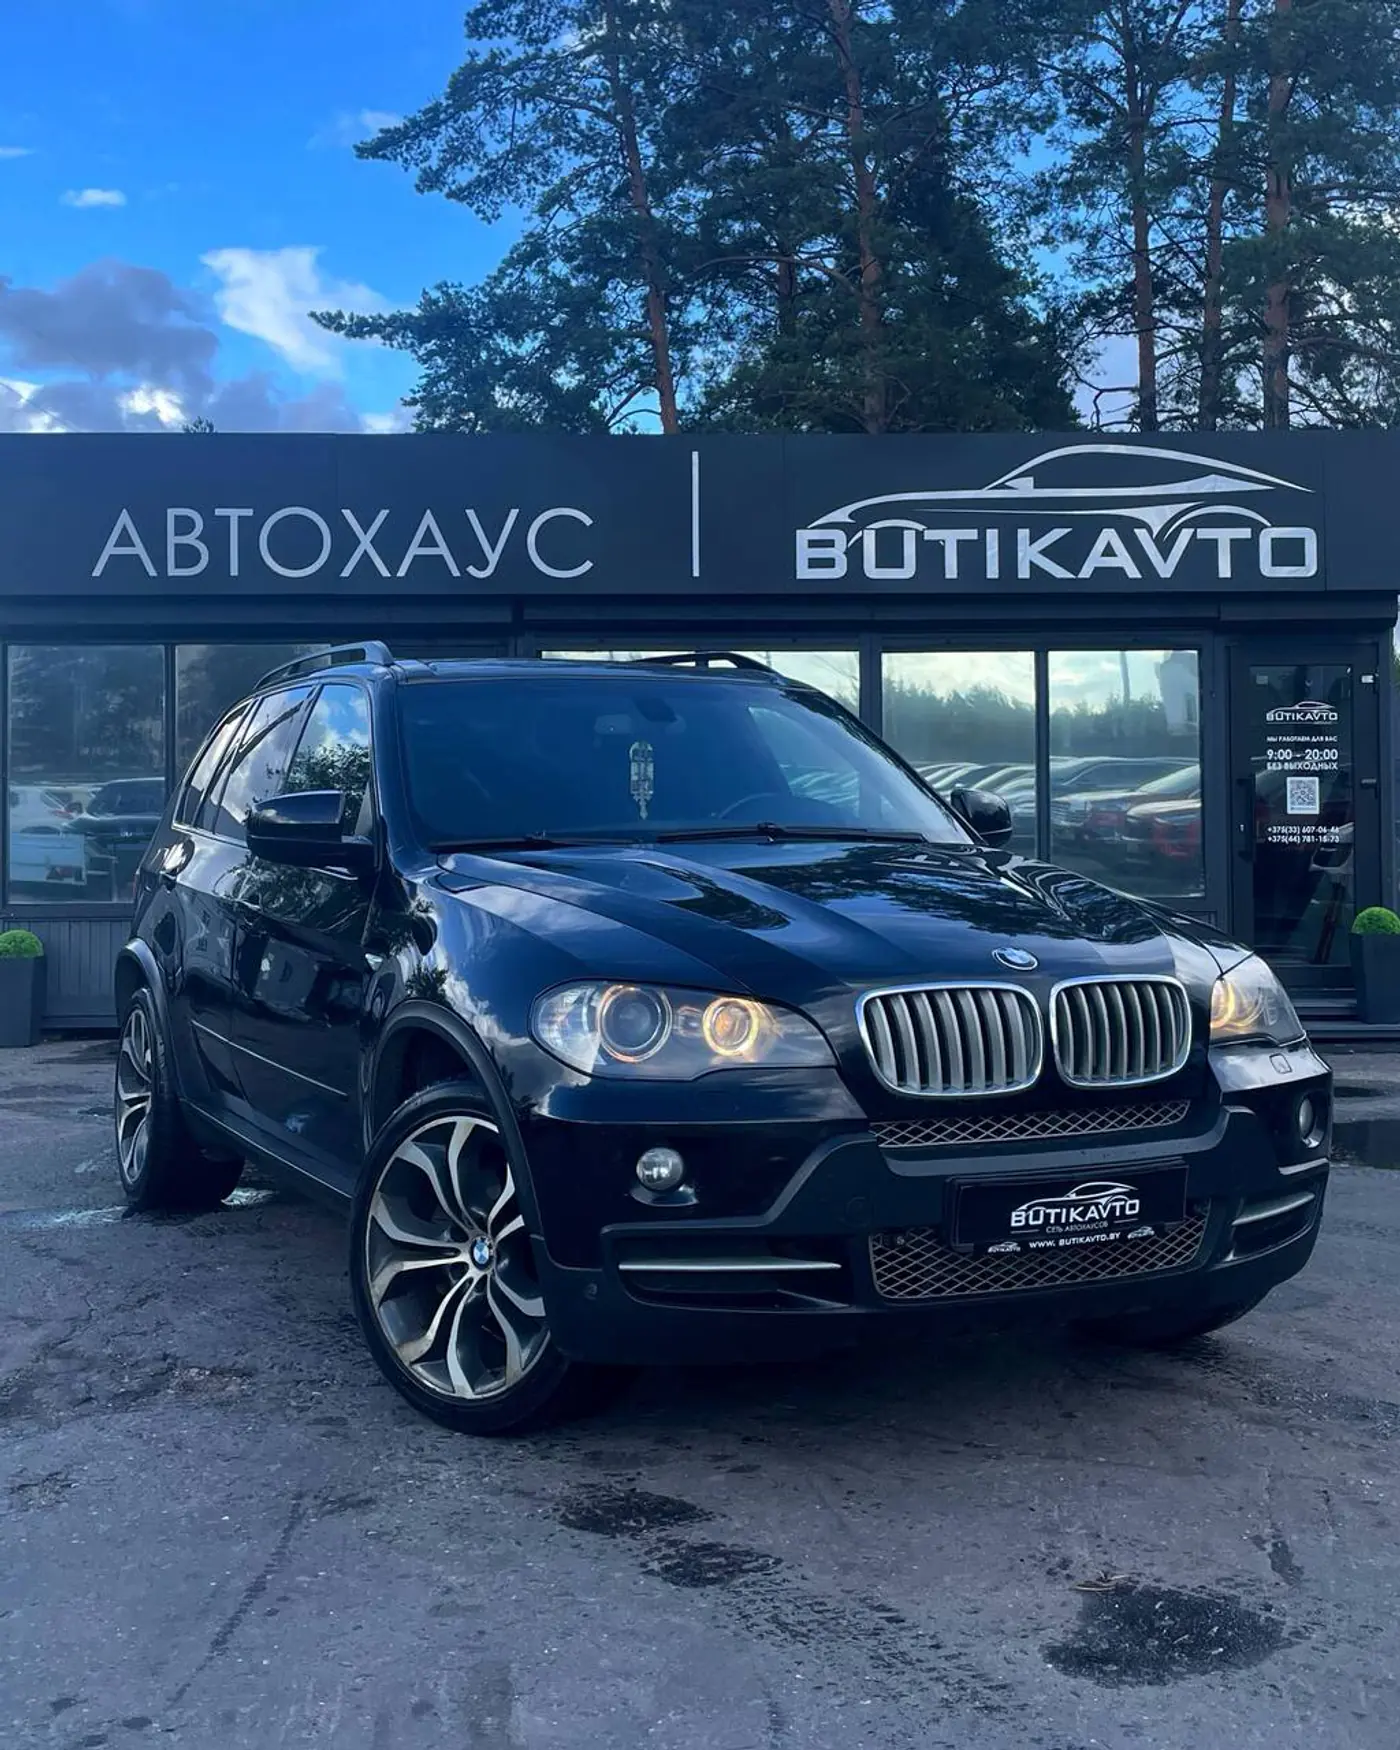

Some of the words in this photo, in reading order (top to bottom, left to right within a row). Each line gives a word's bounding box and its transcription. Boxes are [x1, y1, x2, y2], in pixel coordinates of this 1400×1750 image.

[92, 506, 594, 579] АВТОХАУС
[795, 527, 1318, 579] BUTIKAVTO
[1266, 712, 1338, 721] BUTIKAVTO
[1267, 749, 1292, 760] 9:00
[1304, 749, 1338, 760] 20:00
[1283, 762, 1338, 771] ВЫХОДНЫХ
[1011, 1199, 1140, 1227] BUTIKAVTO
